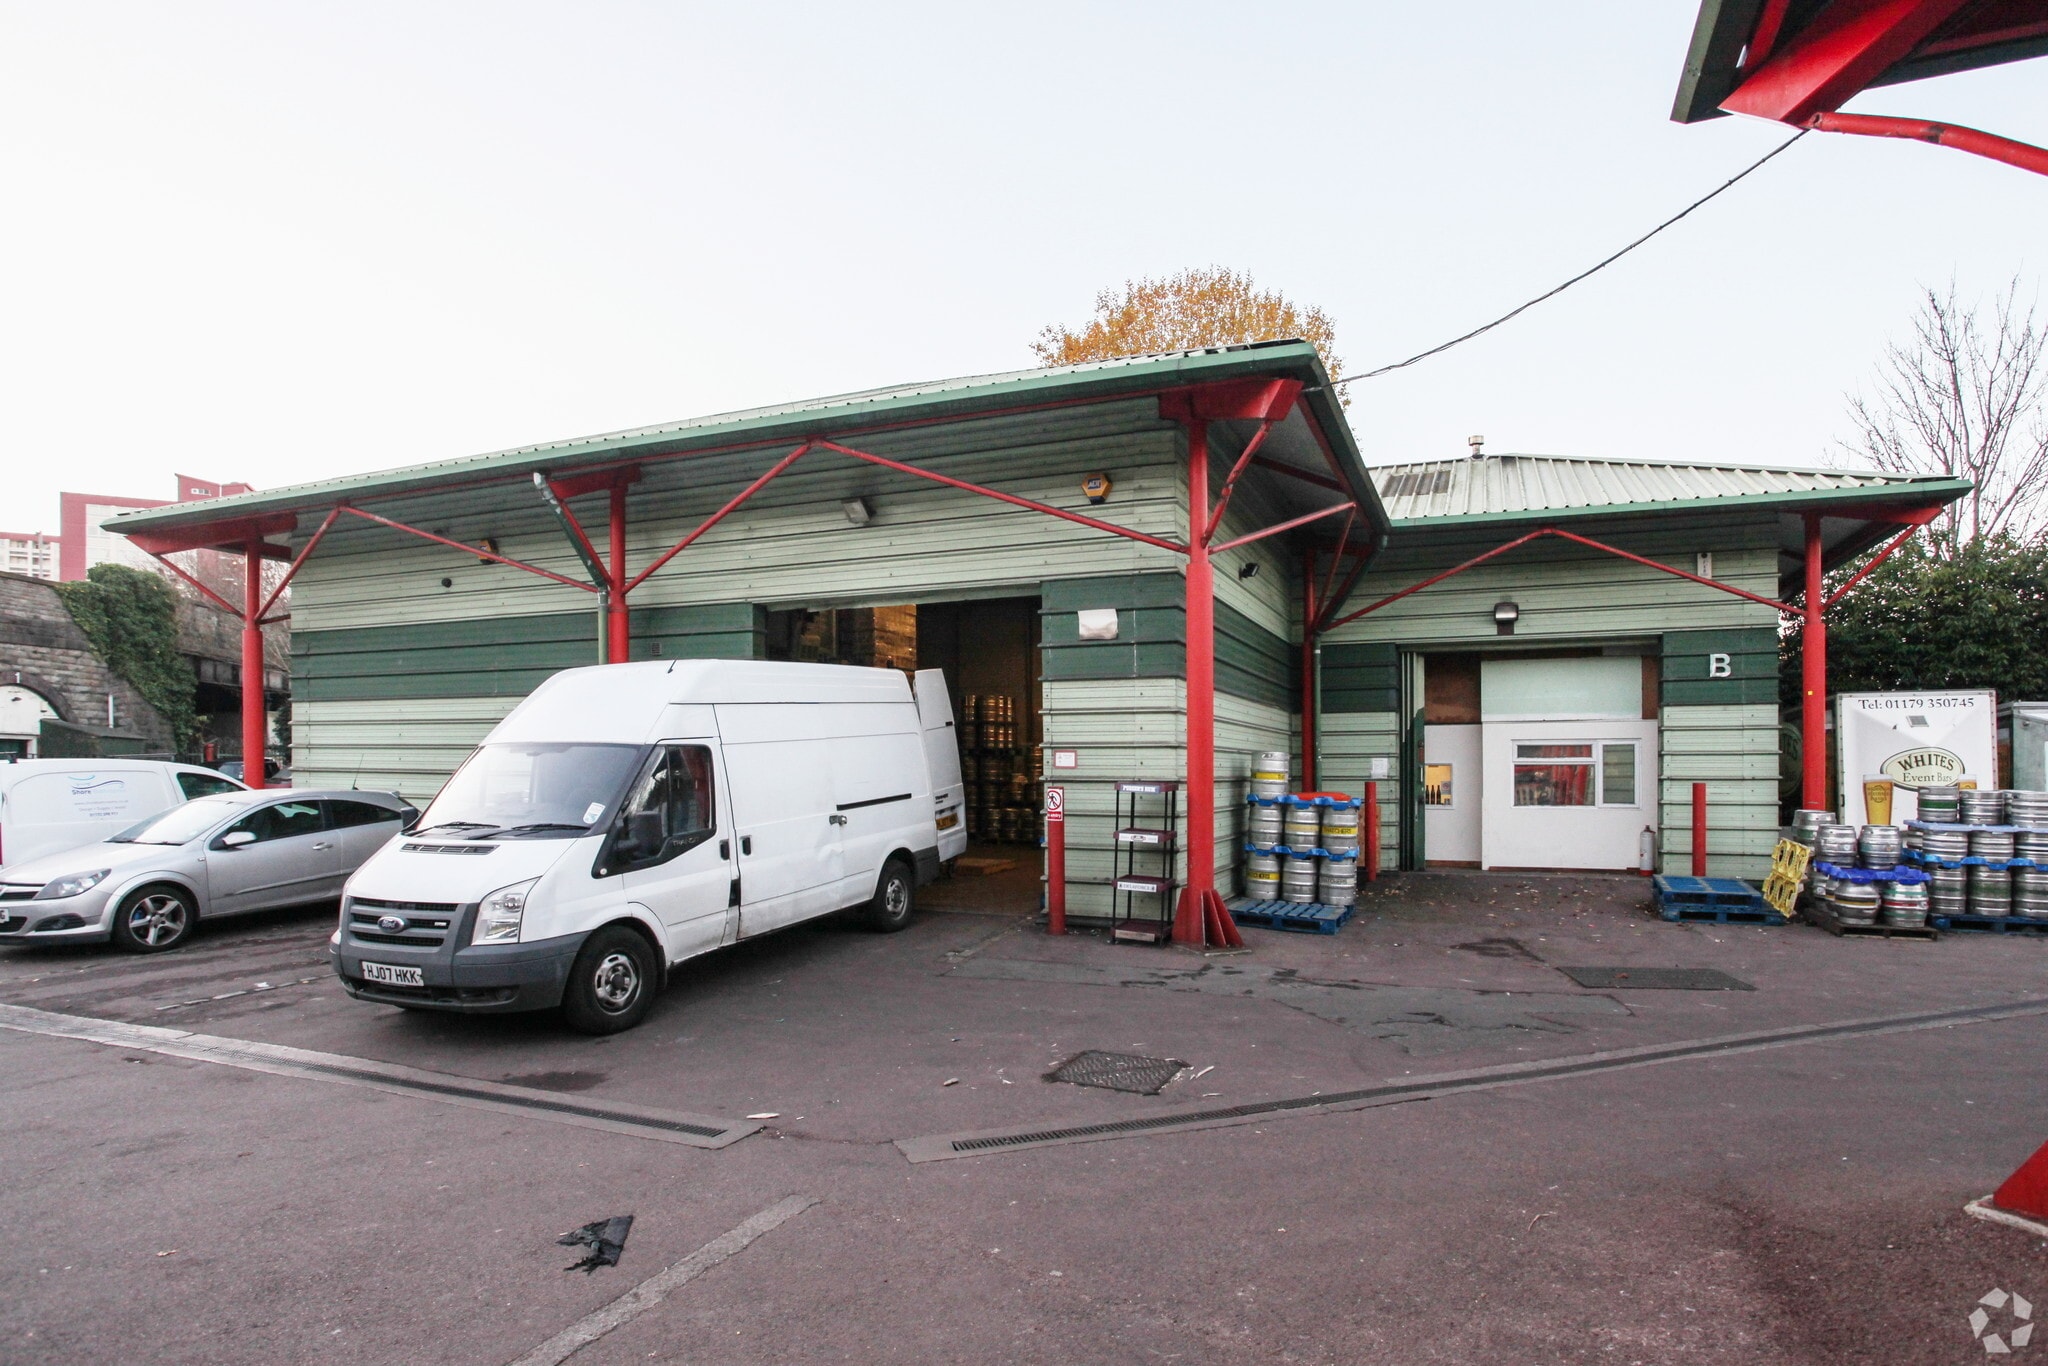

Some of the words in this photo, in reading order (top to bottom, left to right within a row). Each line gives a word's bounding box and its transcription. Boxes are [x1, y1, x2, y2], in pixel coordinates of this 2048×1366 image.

[1710, 653, 1731, 677] B
[1858, 699, 1883, 710] Tel:
[1885, 699, 1924, 709] 01179
[1928, 697, 1975, 708] 350745
[1897, 753, 1955, 772] WHITES
[1903, 772, 1935, 783] Event
[366, 964, 392, 980] HJ07
[394, 968, 419, 984] HKK
